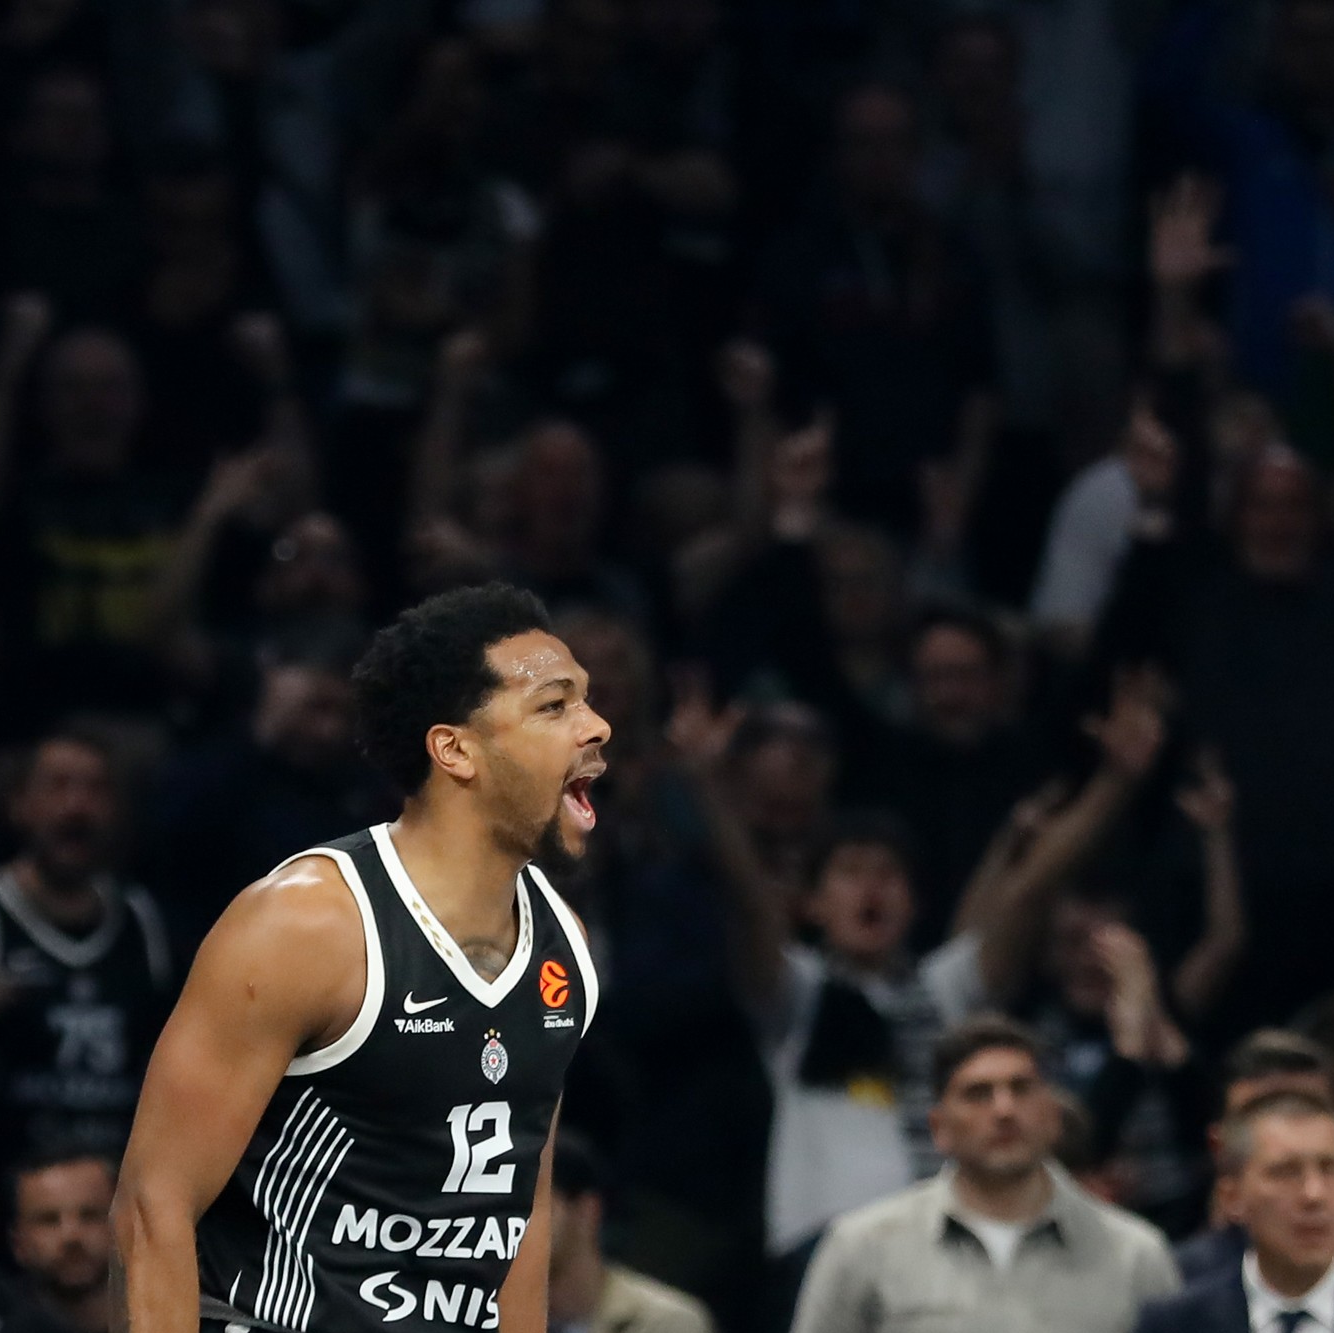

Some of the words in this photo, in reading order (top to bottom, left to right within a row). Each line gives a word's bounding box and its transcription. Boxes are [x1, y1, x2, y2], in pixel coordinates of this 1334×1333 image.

[403, 1017, 455, 1034] AikBank
[441, 1101, 516, 1194] 12
[331, 1204, 530, 1261] MOZZAR
